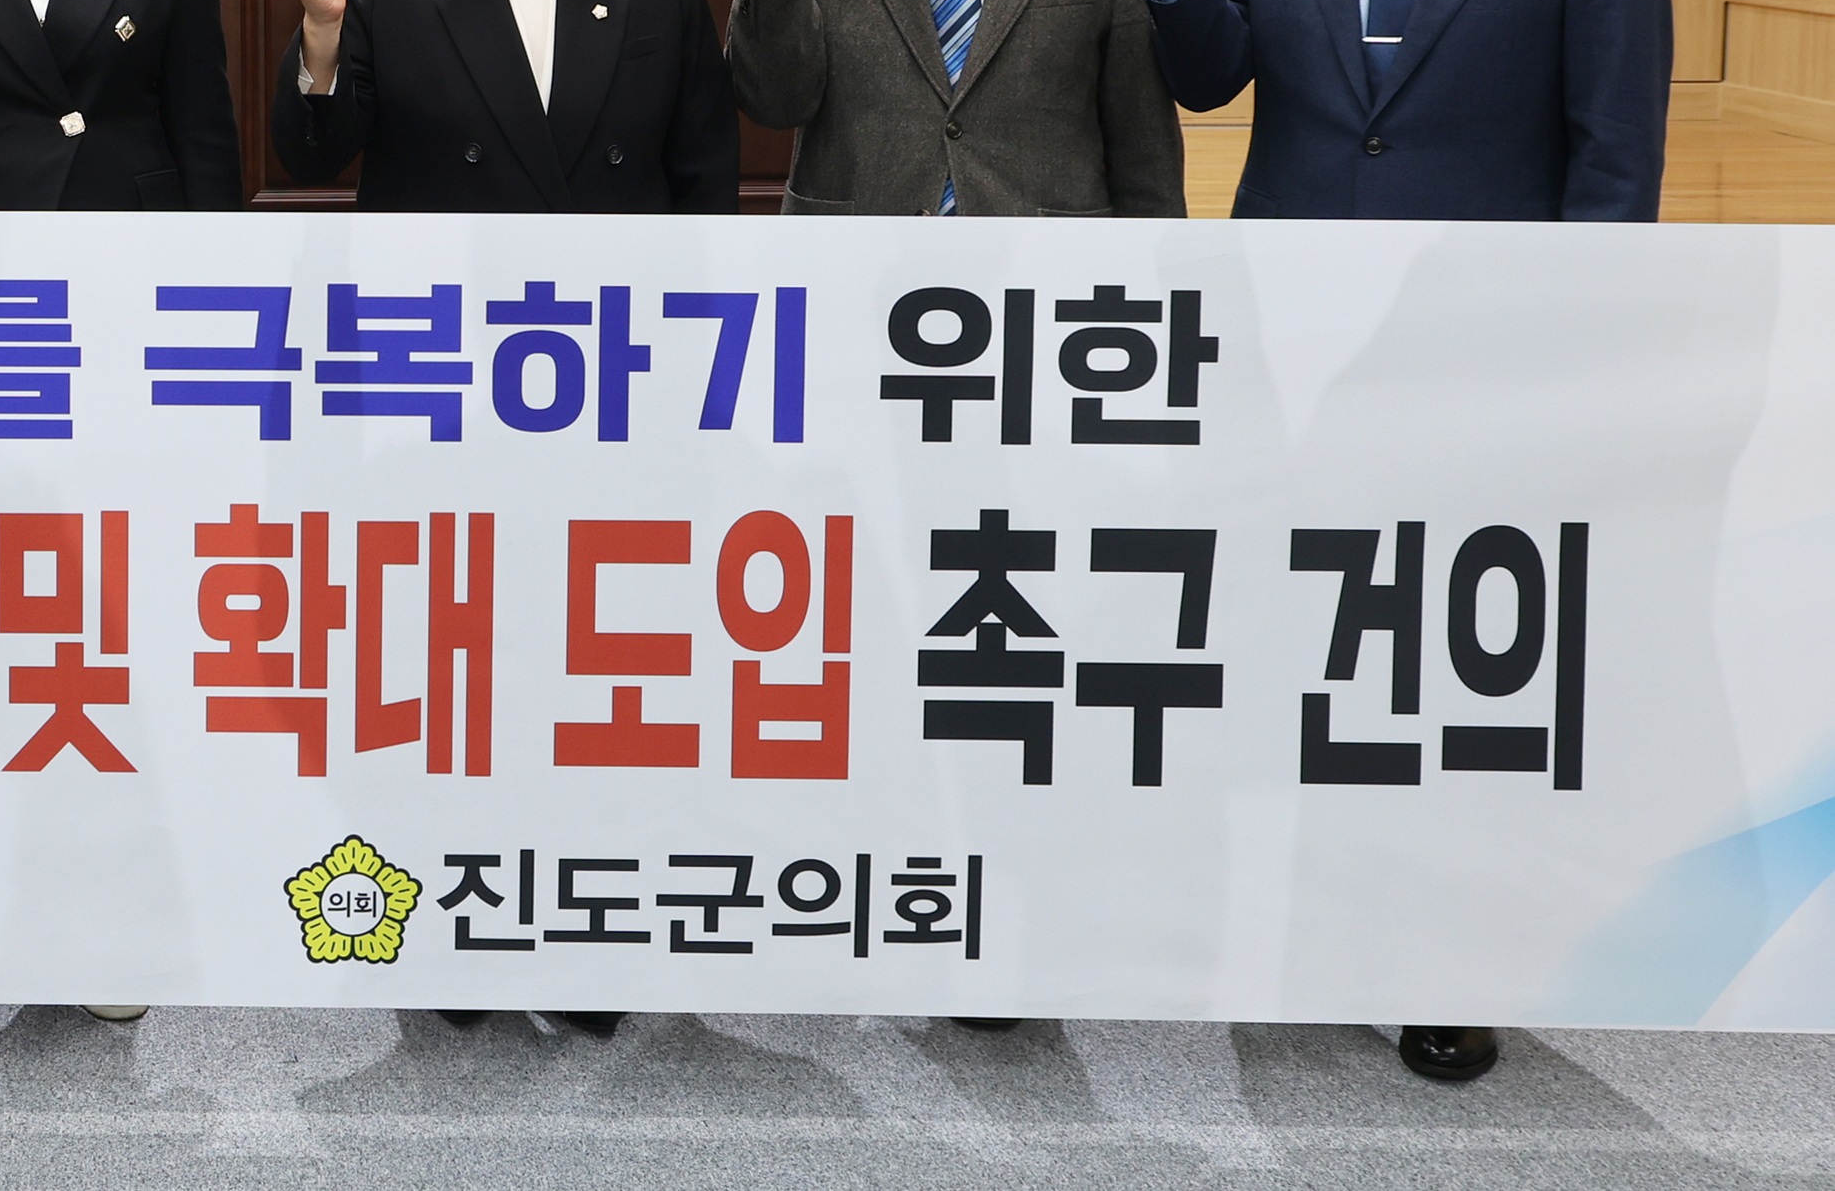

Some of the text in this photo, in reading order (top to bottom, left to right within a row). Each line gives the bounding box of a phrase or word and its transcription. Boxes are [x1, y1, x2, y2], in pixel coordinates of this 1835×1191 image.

[143, 280, 808, 445] 극복하기
[878, 283, 1220, 447] 위한
[192, 502, 496, 778] 확대
[552, 509, 855, 781] 도입
[916, 507, 1225, 788] 촉구
[1288, 519, 1591, 792] 건의
[327, 890, 377, 918] 의회
[435, 847, 984, 961] 진도군의회
